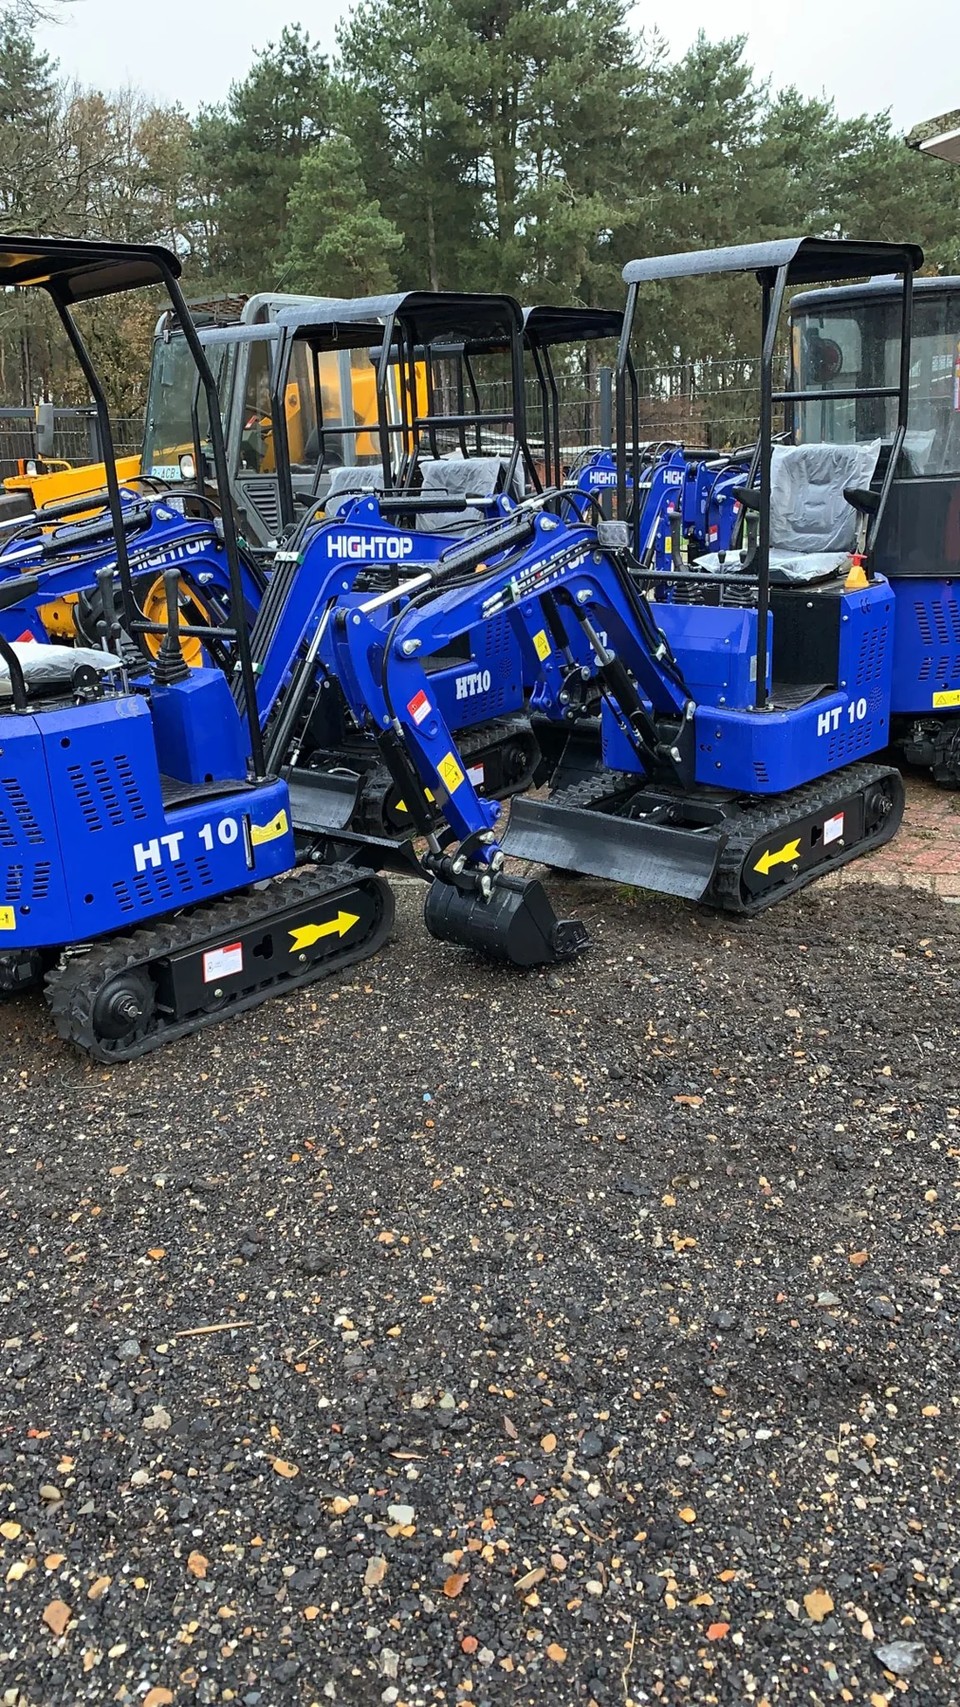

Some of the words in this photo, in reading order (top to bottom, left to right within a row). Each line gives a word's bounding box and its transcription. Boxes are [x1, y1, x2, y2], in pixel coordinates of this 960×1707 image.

[589, 470, 627, 485] HIGHT
[327, 535, 413, 559] HIGHTOP
[455, 669, 491, 700] HT10
[817, 706, 842, 737] HT
[848, 698, 867, 724] 10
[133, 831, 184, 872] HT
[198, 817, 238, 851] 10
